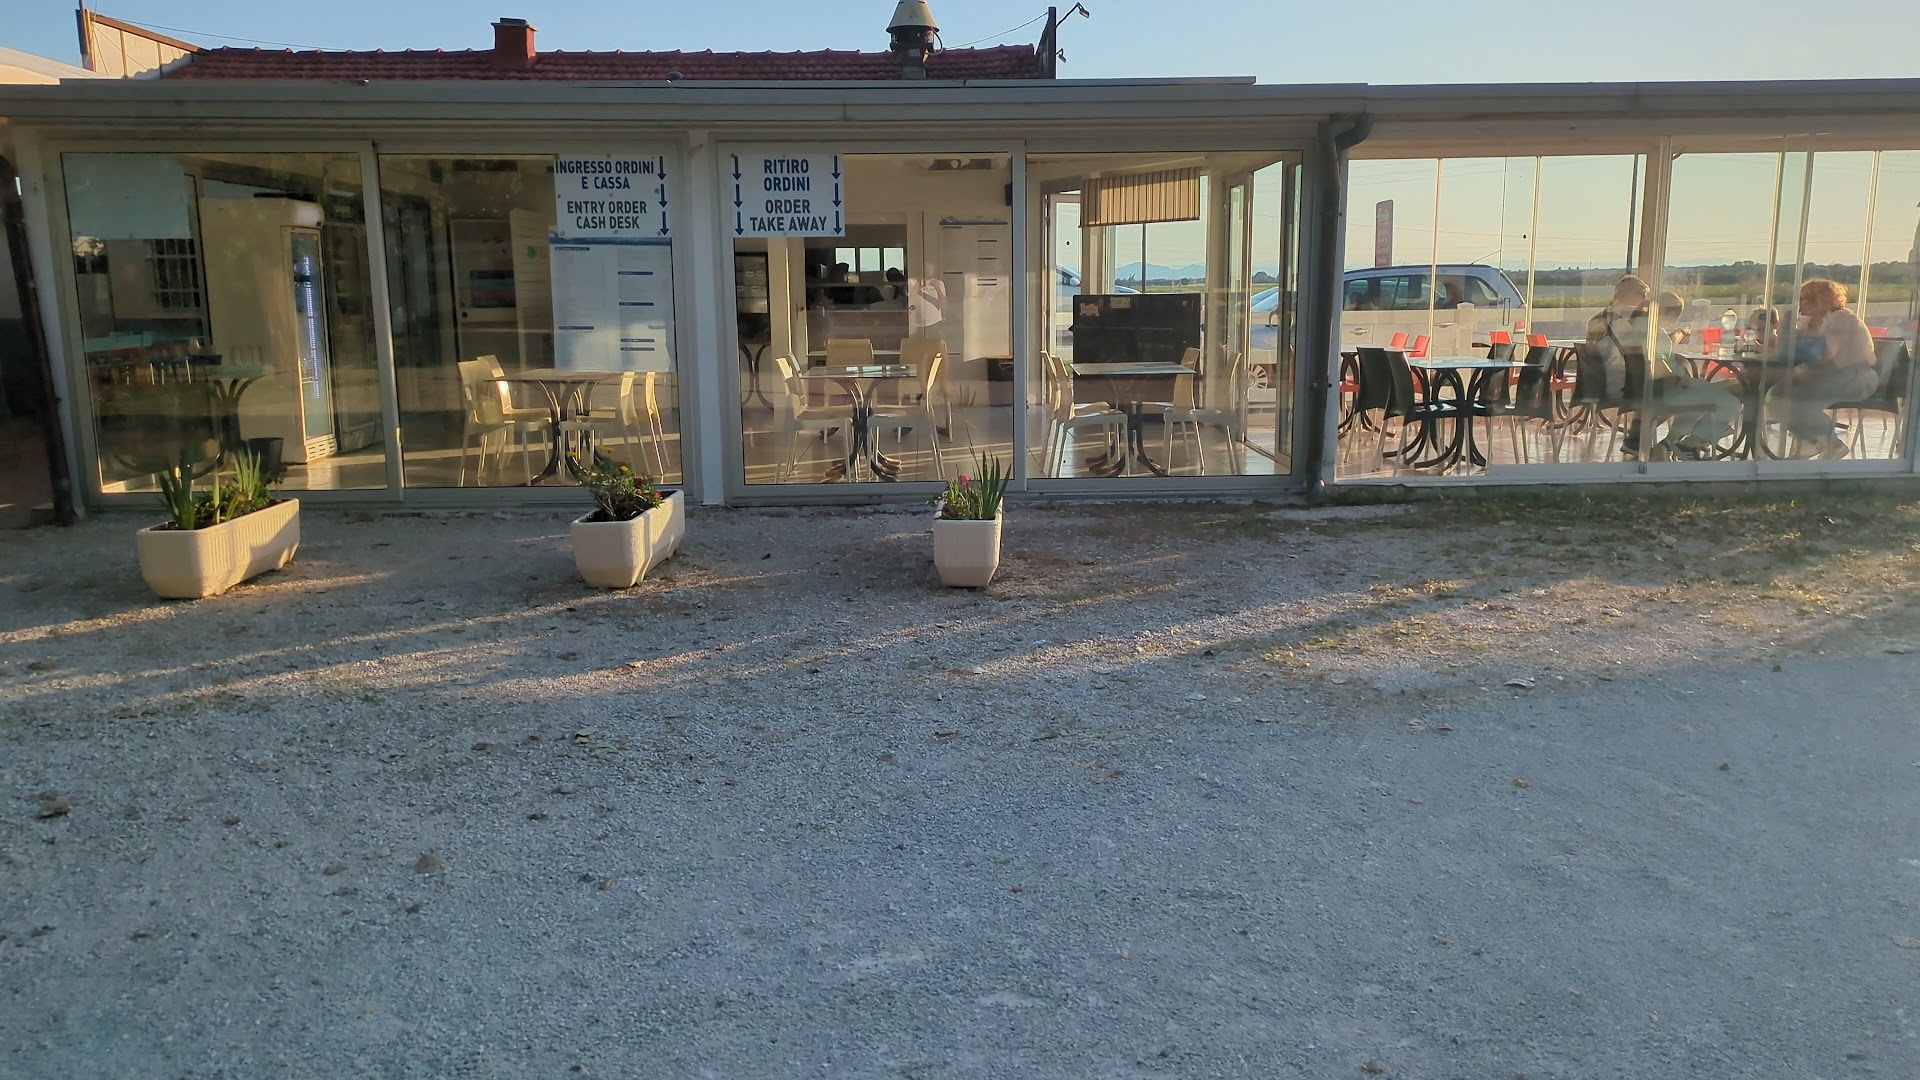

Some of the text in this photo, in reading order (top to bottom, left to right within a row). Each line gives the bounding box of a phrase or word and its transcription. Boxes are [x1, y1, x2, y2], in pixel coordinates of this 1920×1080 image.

[555, 160, 654, 174] INGRESSO ORDINI
[763, 159, 809, 174] RITIRO
[581, 176, 630, 190] E CASSA
[763, 176, 810, 192] ORDINI
[567, 200, 647, 214] ENTRY ORDER
[765, 199, 811, 214] ORDER
[576, 216, 640, 230] CASH DESK
[750, 217, 827, 232] TAKE AWAY
